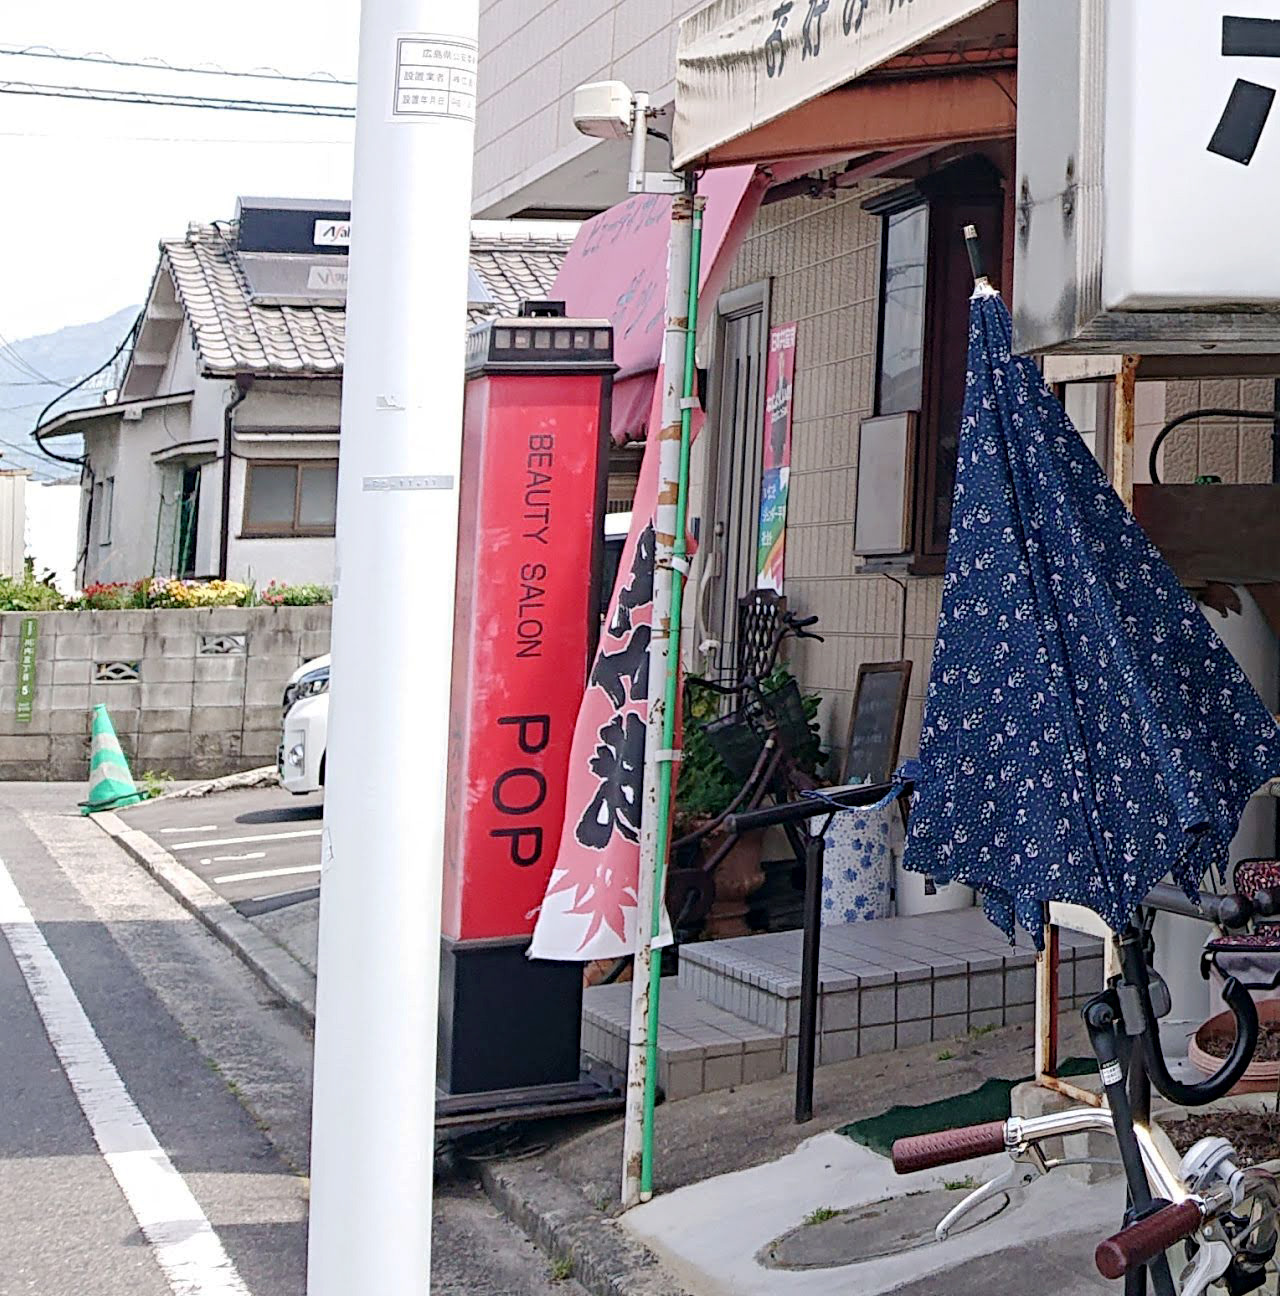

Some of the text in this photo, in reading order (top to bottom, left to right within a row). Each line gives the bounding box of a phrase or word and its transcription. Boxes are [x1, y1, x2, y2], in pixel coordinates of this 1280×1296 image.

[489, 434, 553, 867] BEAUTY SALON POP
